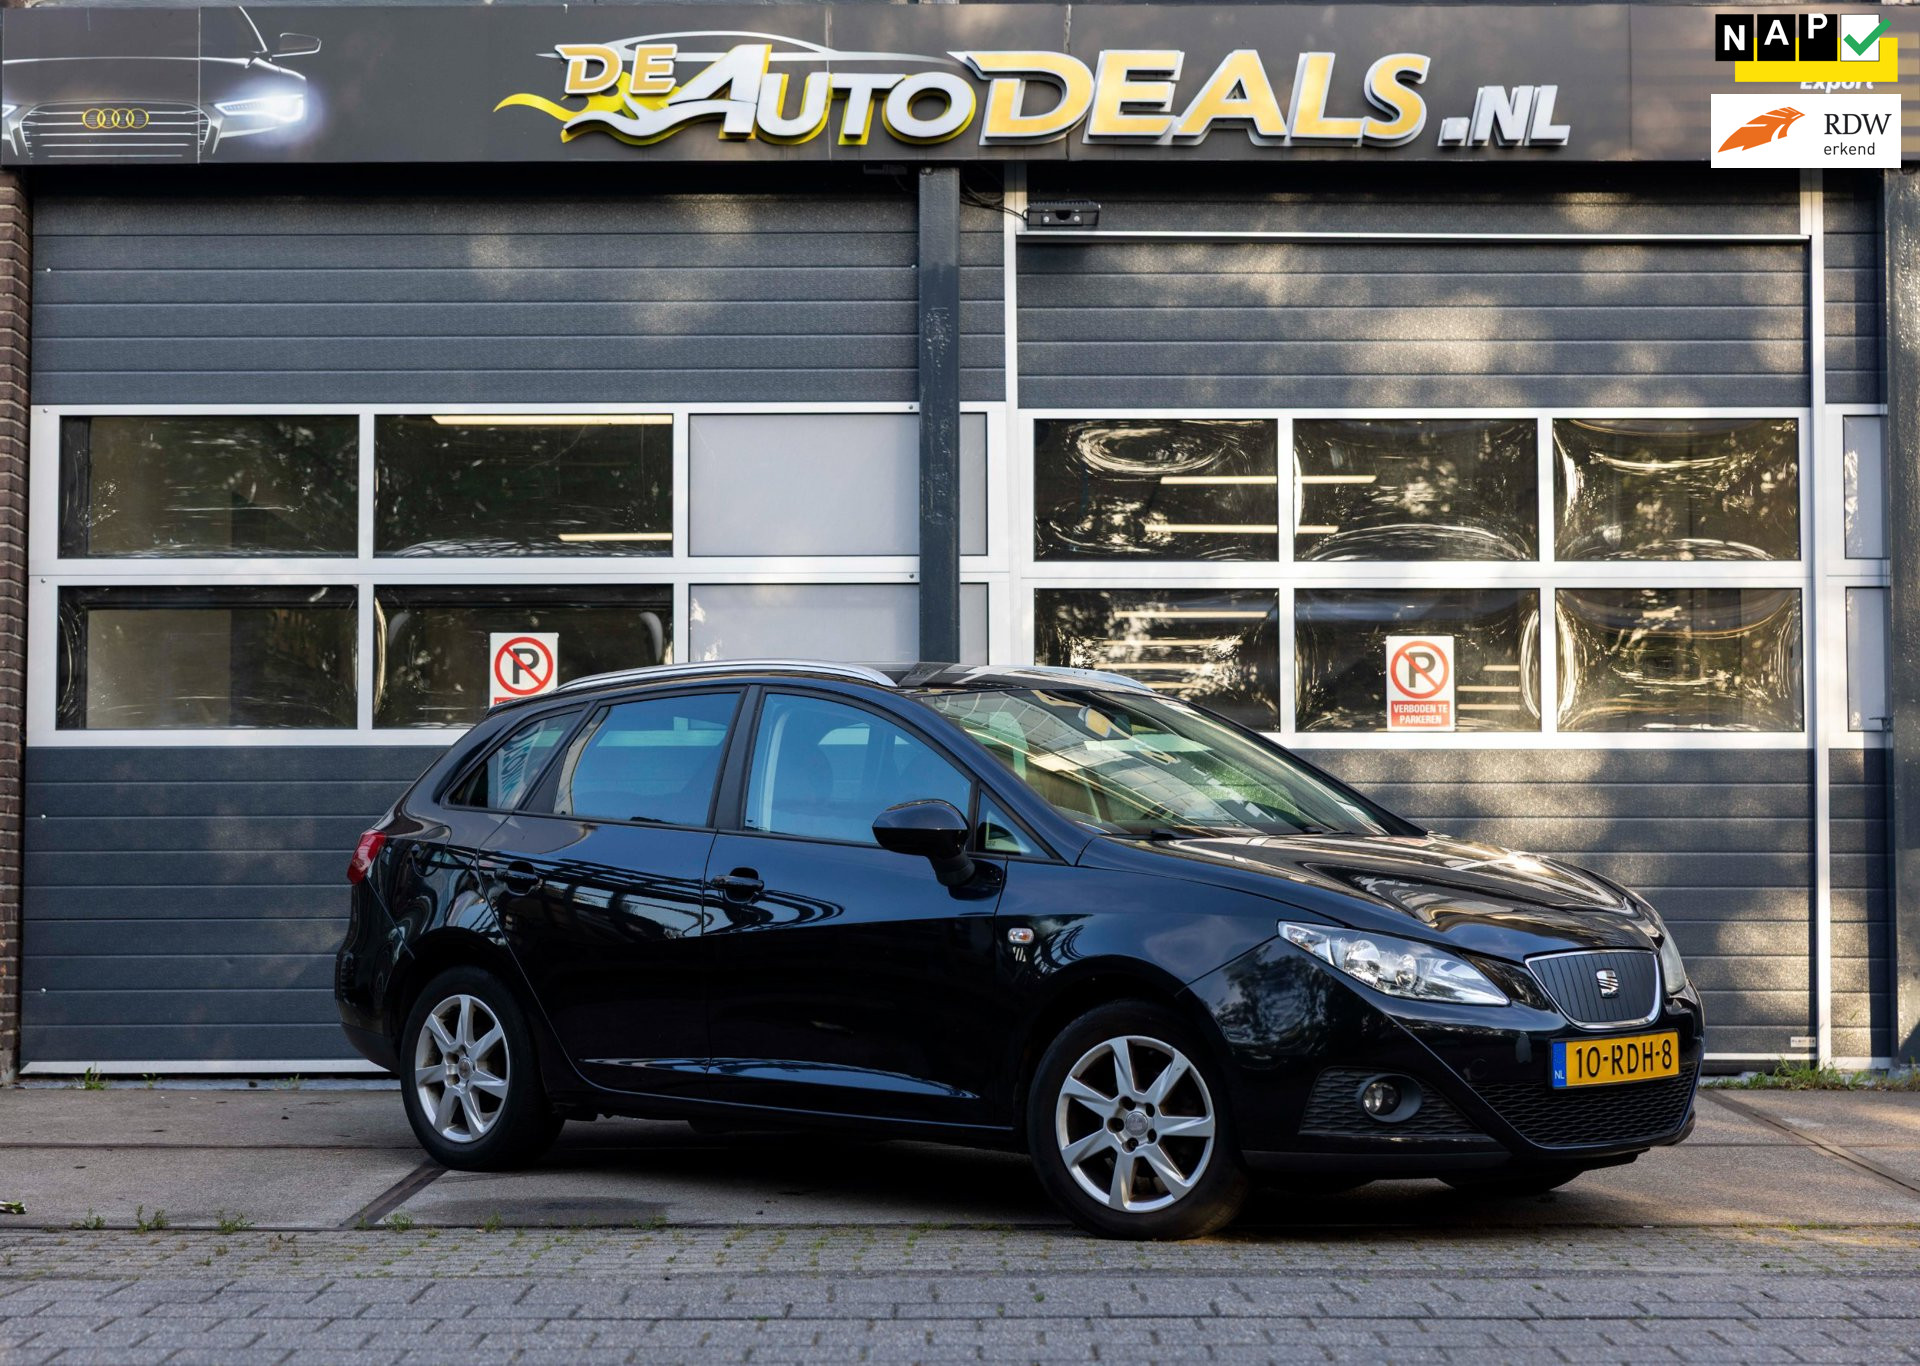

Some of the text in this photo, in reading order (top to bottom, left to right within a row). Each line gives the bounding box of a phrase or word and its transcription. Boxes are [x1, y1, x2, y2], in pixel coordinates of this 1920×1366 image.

[555, 44, 678, 95] DE
[512, 648, 540, 685] P
[1408, 651, 1436, 688] P
[1393, 703, 1448, 713] VERBODEN TE
[1399, 714, 1442, 724] PARKEREN
[1554, 1070, 1565, 1080] NL
[1575, 1039, 1672, 1079] 10-RDH-8
